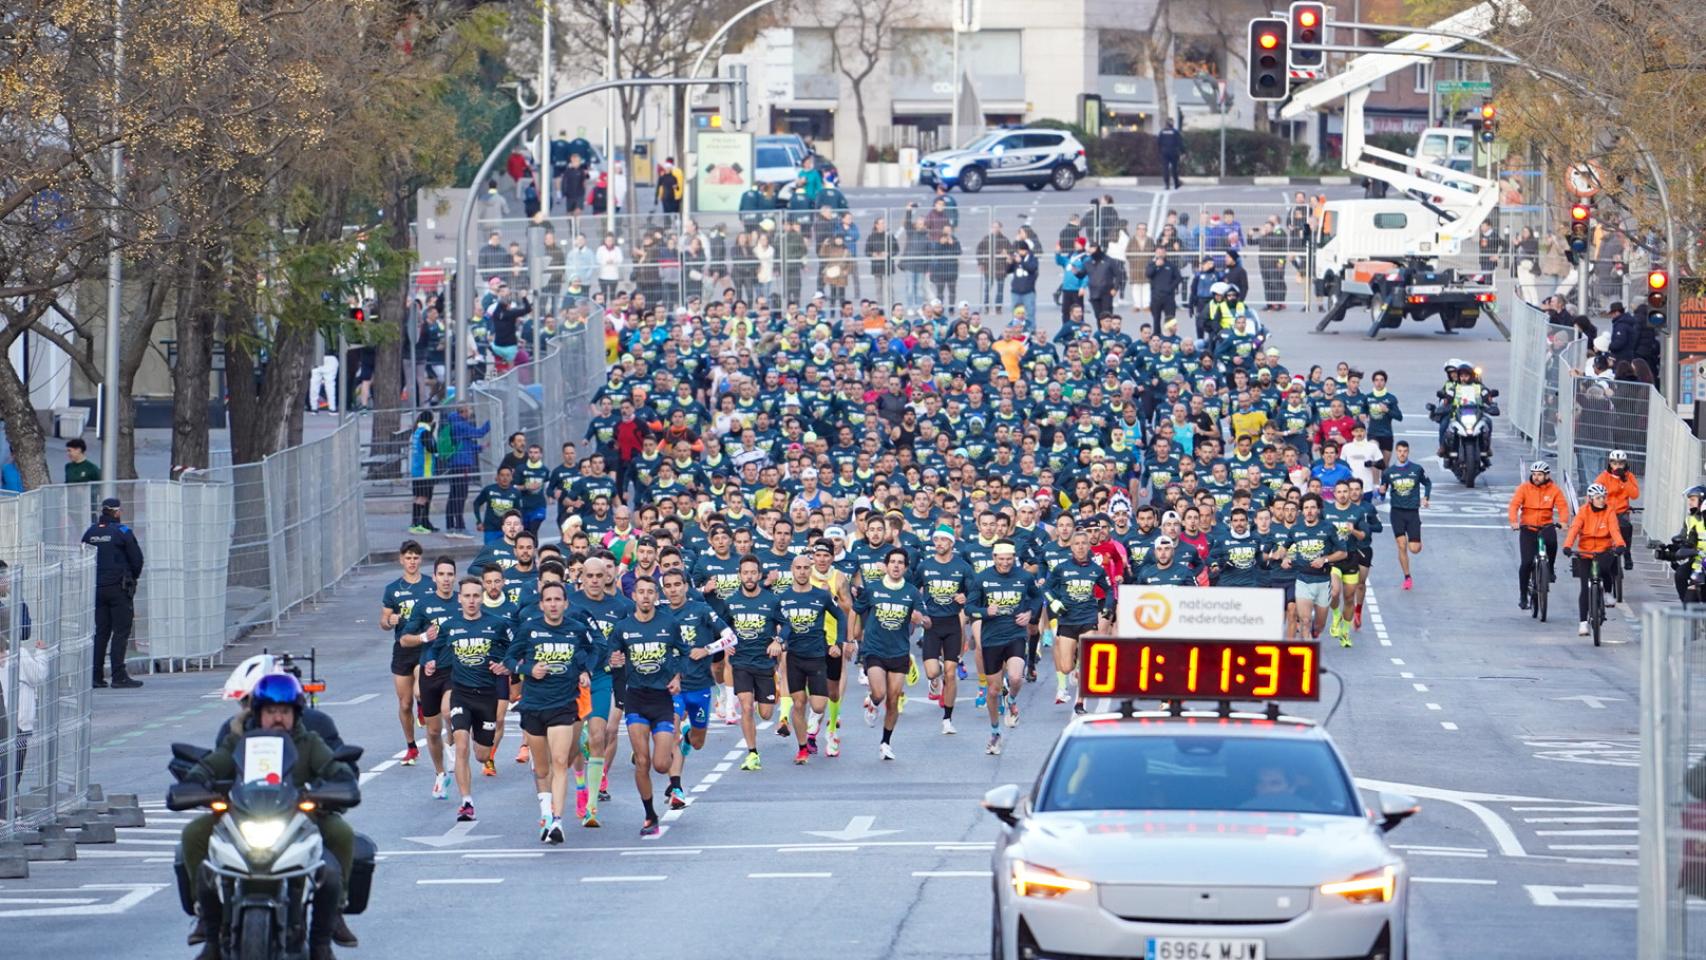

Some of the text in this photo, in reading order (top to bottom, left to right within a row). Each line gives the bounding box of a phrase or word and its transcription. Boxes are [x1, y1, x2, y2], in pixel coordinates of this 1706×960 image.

[1179, 597, 1243, 611] nationale
[1179, 612, 1265, 625] nederlanden
[1088, 643, 1313, 696] 01:11:37
[1160, 941, 1211, 960] 6964
